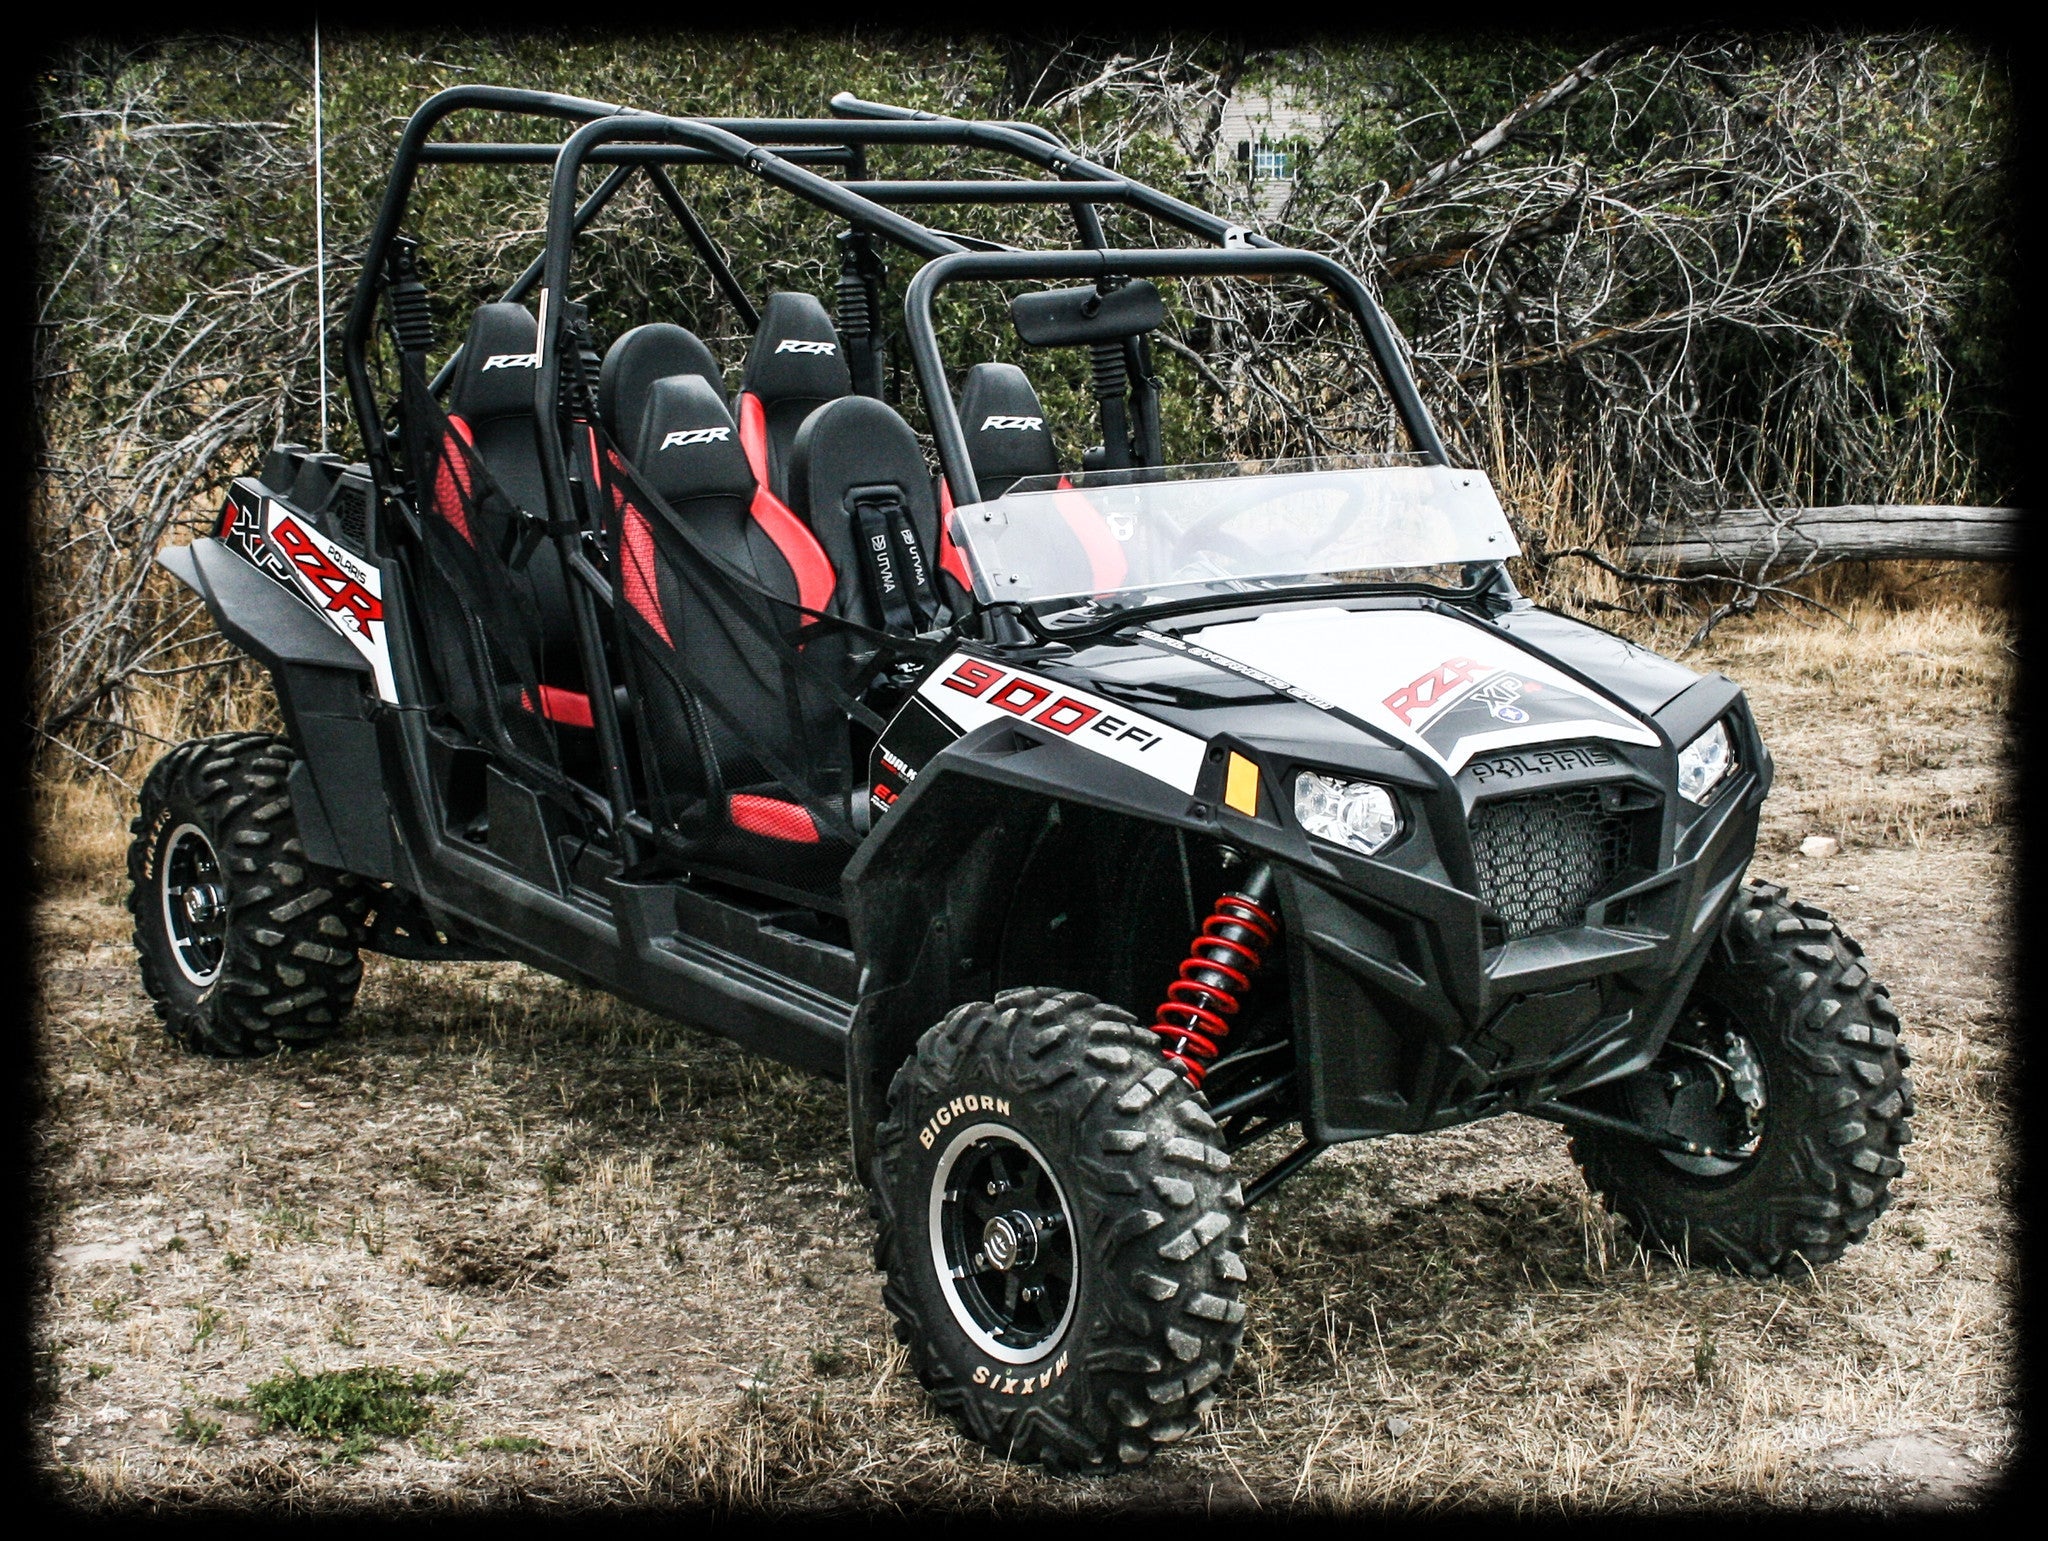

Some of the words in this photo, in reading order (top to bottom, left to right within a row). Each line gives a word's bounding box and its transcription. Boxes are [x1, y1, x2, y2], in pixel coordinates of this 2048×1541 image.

[774, 339, 837, 356] RZR
[660, 426, 731, 451] RZR
[980, 415, 1043, 432] RZR
[271, 516, 384, 645] RZR
[327, 545, 368, 585] POLARIS
[941, 658, 1102, 736] 900
[1090, 715, 1164, 752] EFI
[1381, 656, 1497, 727] RZR
[1472, 746, 1617, 785] POLARIS
[918, 1093, 1012, 1151] BIGHORN
[971, 1350, 1069, 1396] MAXXIS
